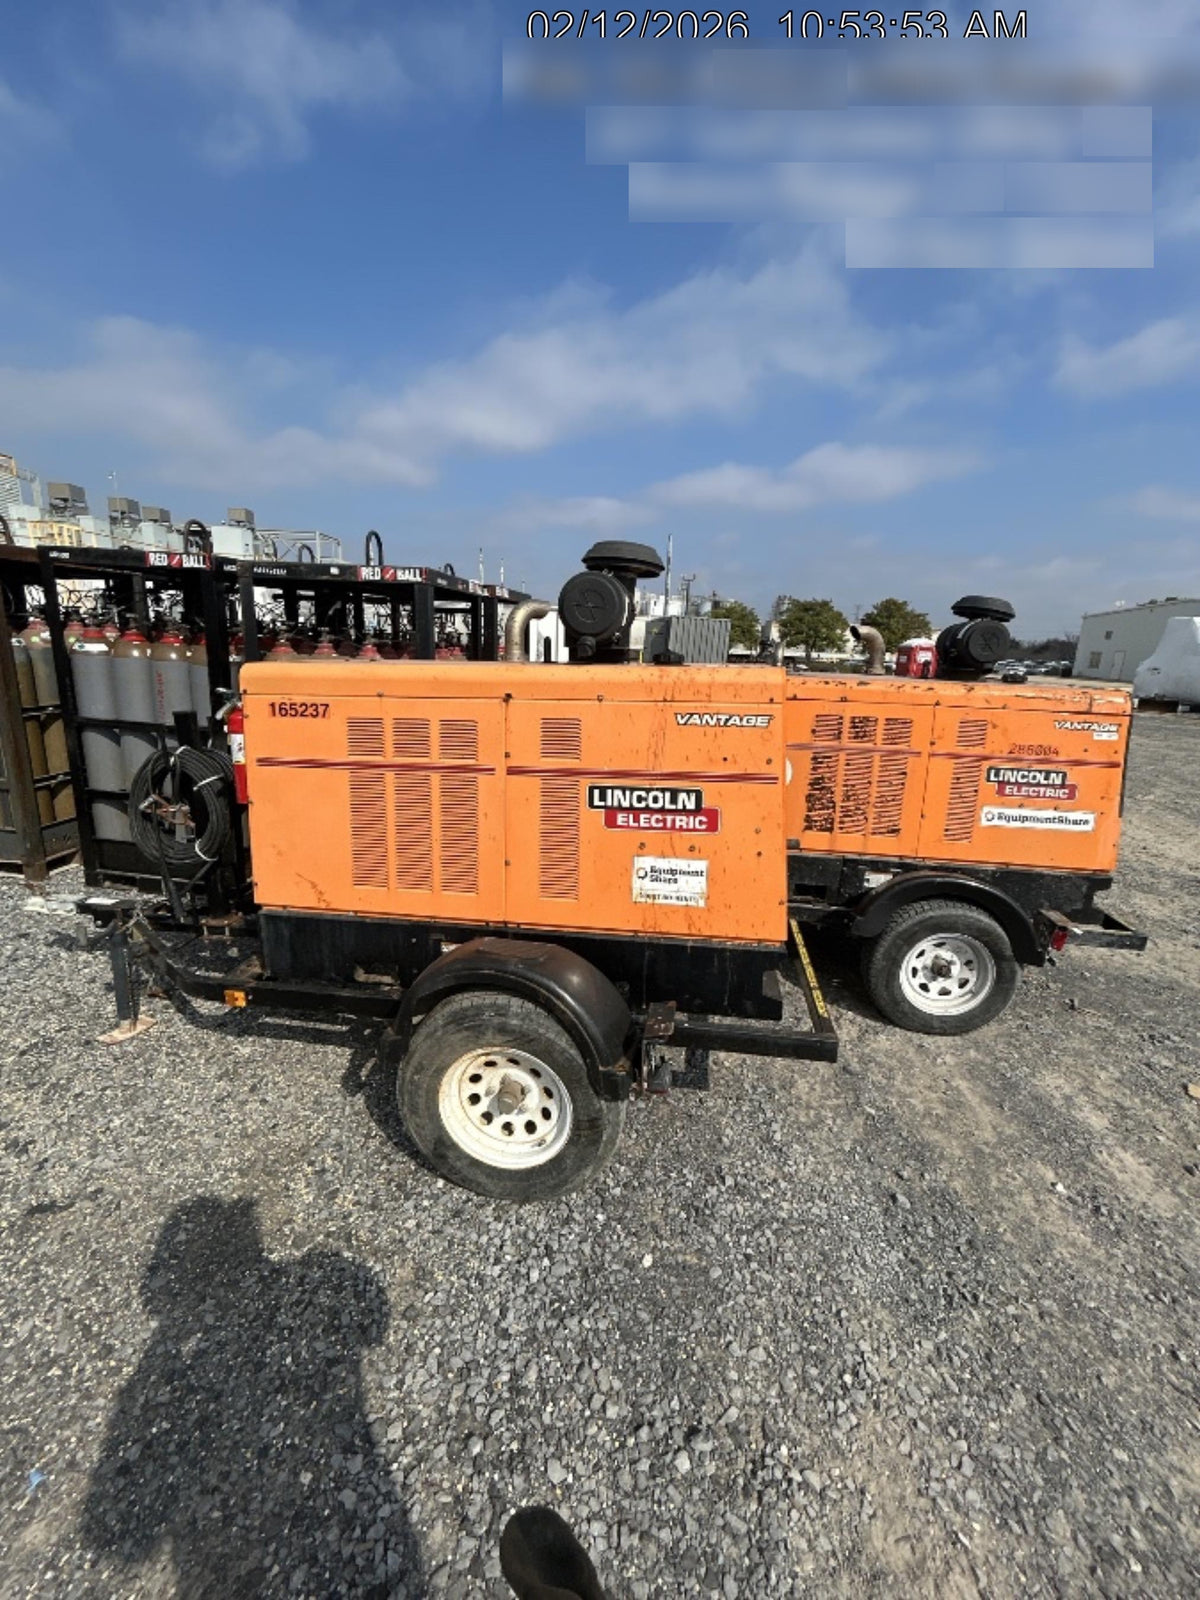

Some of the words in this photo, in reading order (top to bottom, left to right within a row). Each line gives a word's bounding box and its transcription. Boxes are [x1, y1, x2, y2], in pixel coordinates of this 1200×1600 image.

[148, 552, 168, 566] RED
[182, 554, 207, 568] BALL
[361, 566, 381, 580] RED
[396, 567, 422, 581] BALL
[269, 702, 330, 718] 165237
[676, 713, 772, 728] VANTAGE
[1054, 721, 1120, 733] VANTAGE
[988, 769, 1063, 785] LINCOLN
[592, 788, 697, 810] LINCOLN
[1004, 785, 1070, 799] ELECTRIC
[616, 812, 709, 830] ELECTRIC
[997, 811, 1090, 826] EquipmentShare
